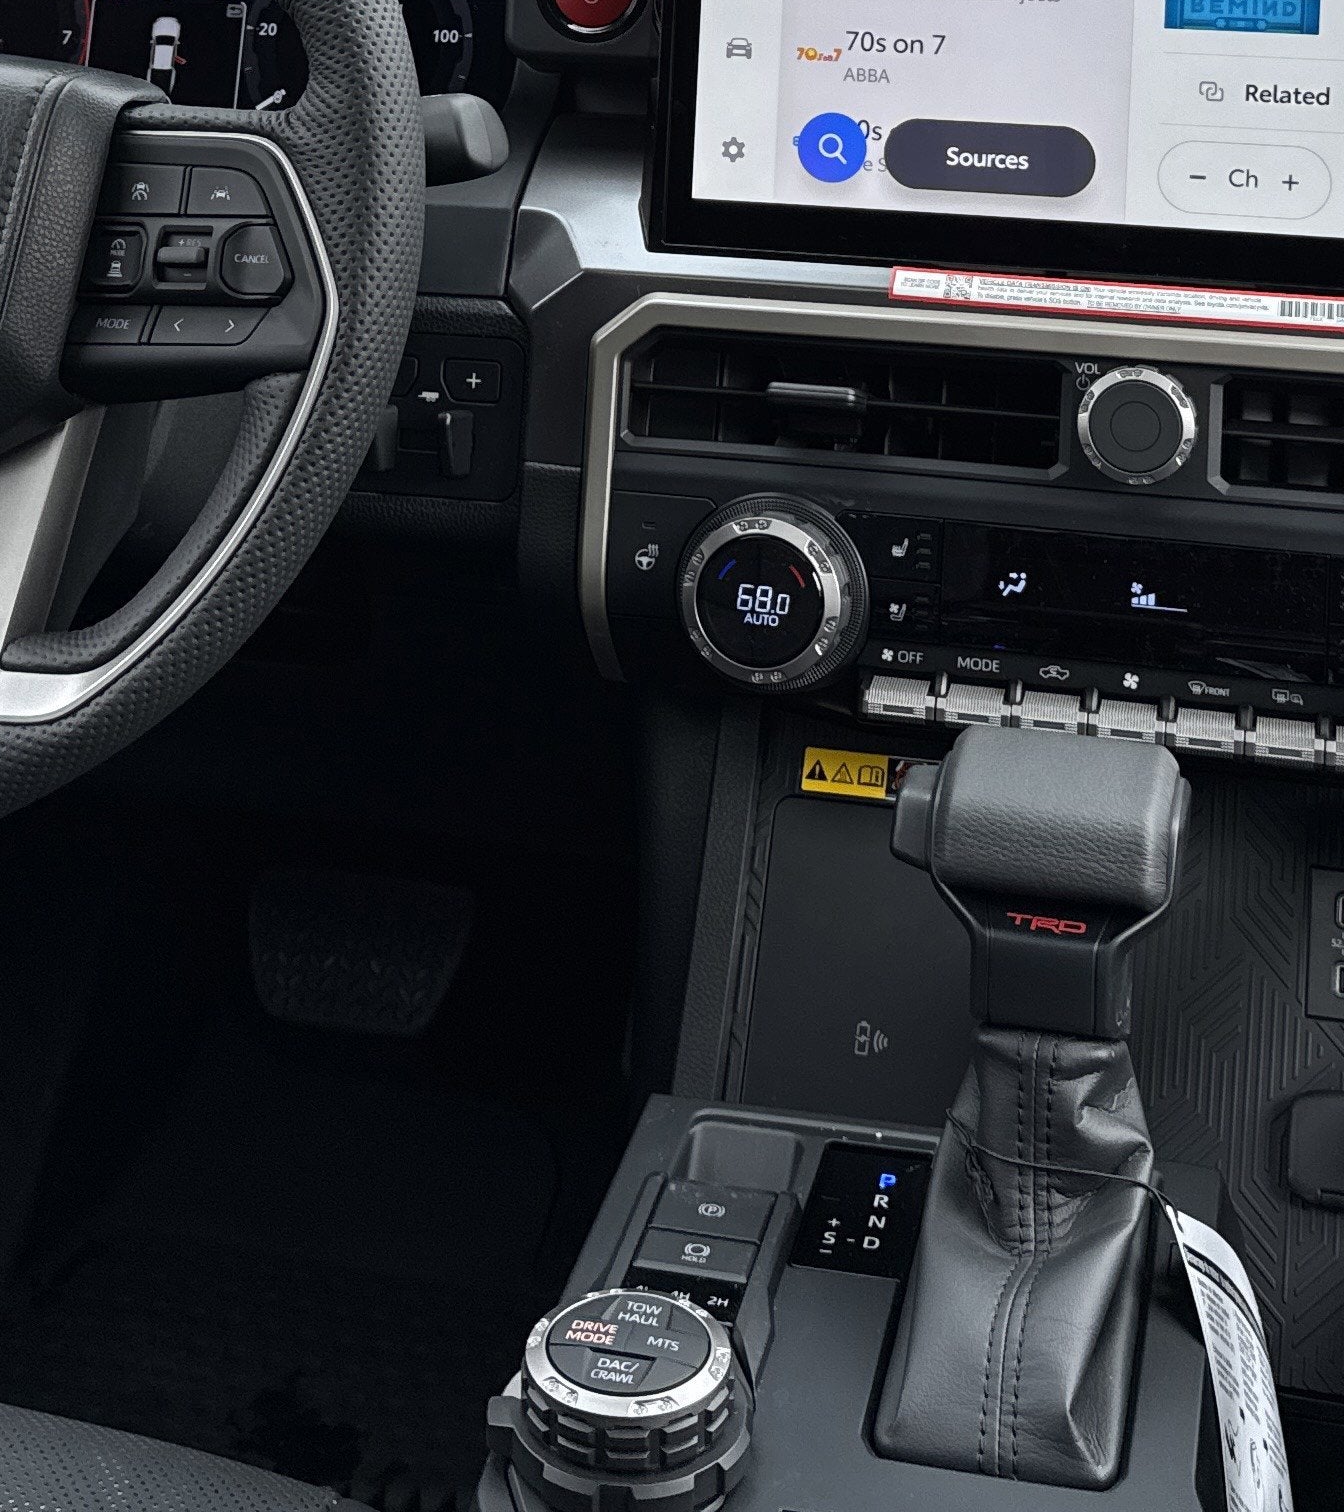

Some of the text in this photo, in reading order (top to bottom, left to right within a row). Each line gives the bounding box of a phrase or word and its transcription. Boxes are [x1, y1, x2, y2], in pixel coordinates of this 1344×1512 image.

[62, 29, 73, 45] 7
[258, 22, 278, 37] 20
[432, 29, 459, 44] 100
[845, 31, 946, 55] 70s on 7
[843, 67, 891, 85] ABBA
[1244, 84, 1331, 107] Related
[945, 147, 1029, 170] Sources
[1228, 168, 1259, 189] Ch
[234, 253, 270, 264] CANCEL
[95, 317, 131, 331] MODE
[1074, 362, 1101, 375] VOL
[736, 583, 790, 616] 68.0
[743, 613, 779, 627] AUTO
[897, 650, 924, 666] OFF
[957, 656, 1000, 673] MODE
[1204, 681, 1231, 697] FRONT
[1006, 911, 1087, 935] TRD
[879, 1174, 897, 1189] P
[873, 1193, 889, 1208] R
[869, 1215, 885, 1231] N
[822, 1231, 837, 1248] S
[863, 1235, 880, 1251] D
[681, 1254, 707, 1264] HOLD
[626, 1299, 663, 1316] TOW
[706, 1295, 729, 1308] 2H
[617, 1311, 659, 1327] HAUL
[571, 1319, 619, 1336] DRIVE
[565, 1330, 615, 1346] MODE
[646, 1336, 680, 1352] MTS
[597, 1357, 640, 1374] DAC/
[590, 1369, 635, 1385] CRAWL
